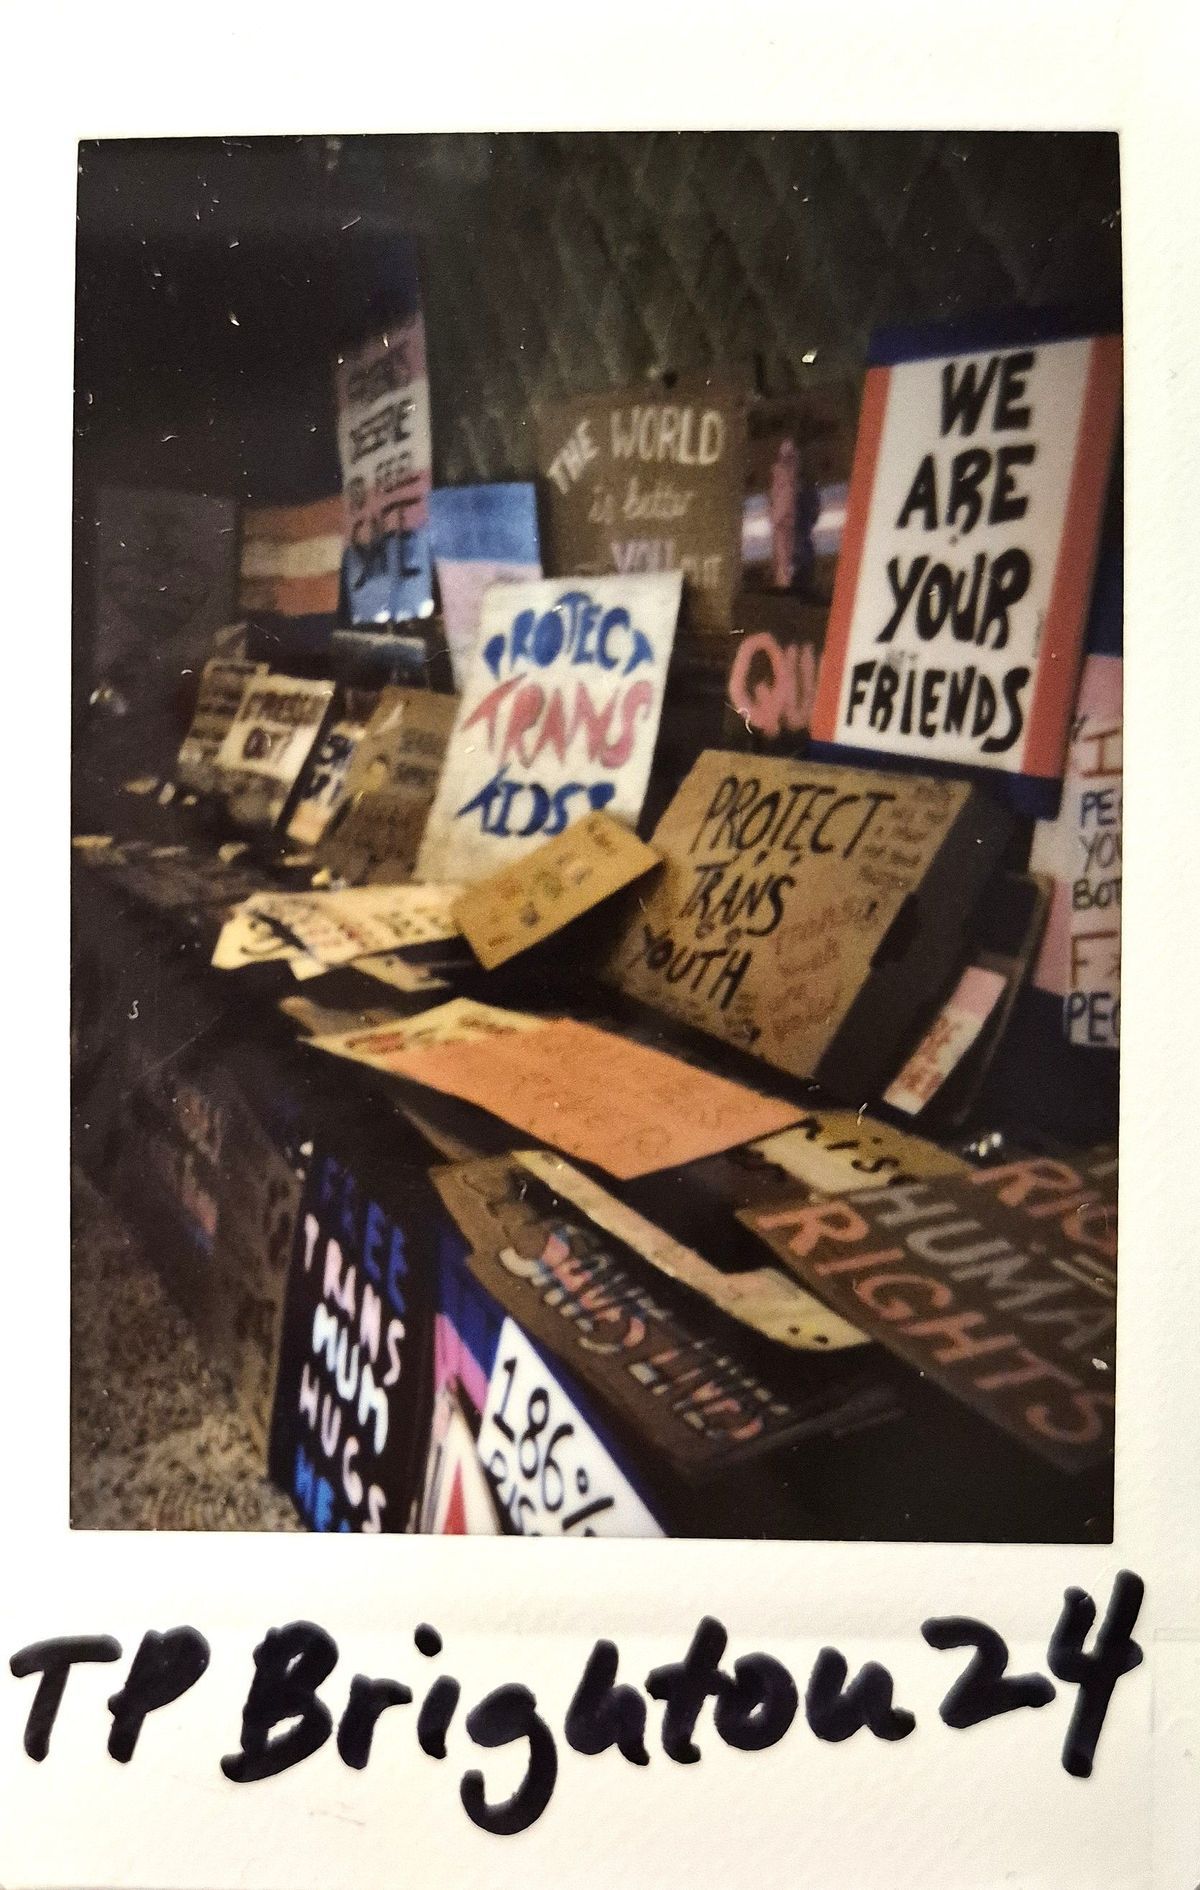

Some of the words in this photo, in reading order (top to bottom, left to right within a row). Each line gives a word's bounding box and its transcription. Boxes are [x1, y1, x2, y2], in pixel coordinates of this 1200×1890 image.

[940, 351, 1037, 438] WE
[548, 419, 599, 494] THE
[610, 404, 726, 467] WORLD
[896, 444, 1037, 535] ARE
[483, 591, 655, 679] PROTECT
[876, 547, 1032, 650] YOUR
[460, 672, 651, 770] TRANS
[845, 661, 1031, 754] FRIENDS
[688, 774, 897, 861] PROTECT
[1080, 788, 1123, 829] PE
[677, 859, 797, 938] TRANS
[627, 924, 753, 1011] YOUTH
[1062, 990, 1121, 1044] PE
[303, 1213, 405, 1386] TRANS
[849, 1184, 1116, 1353] HUMA
[755, 1202, 1117, 1446] RIGHTS
[9, 1624, 211, 1764] TP
[220, 1619, 915, 1836] Brighton
[919, 1568, 1145, 1778] 24
